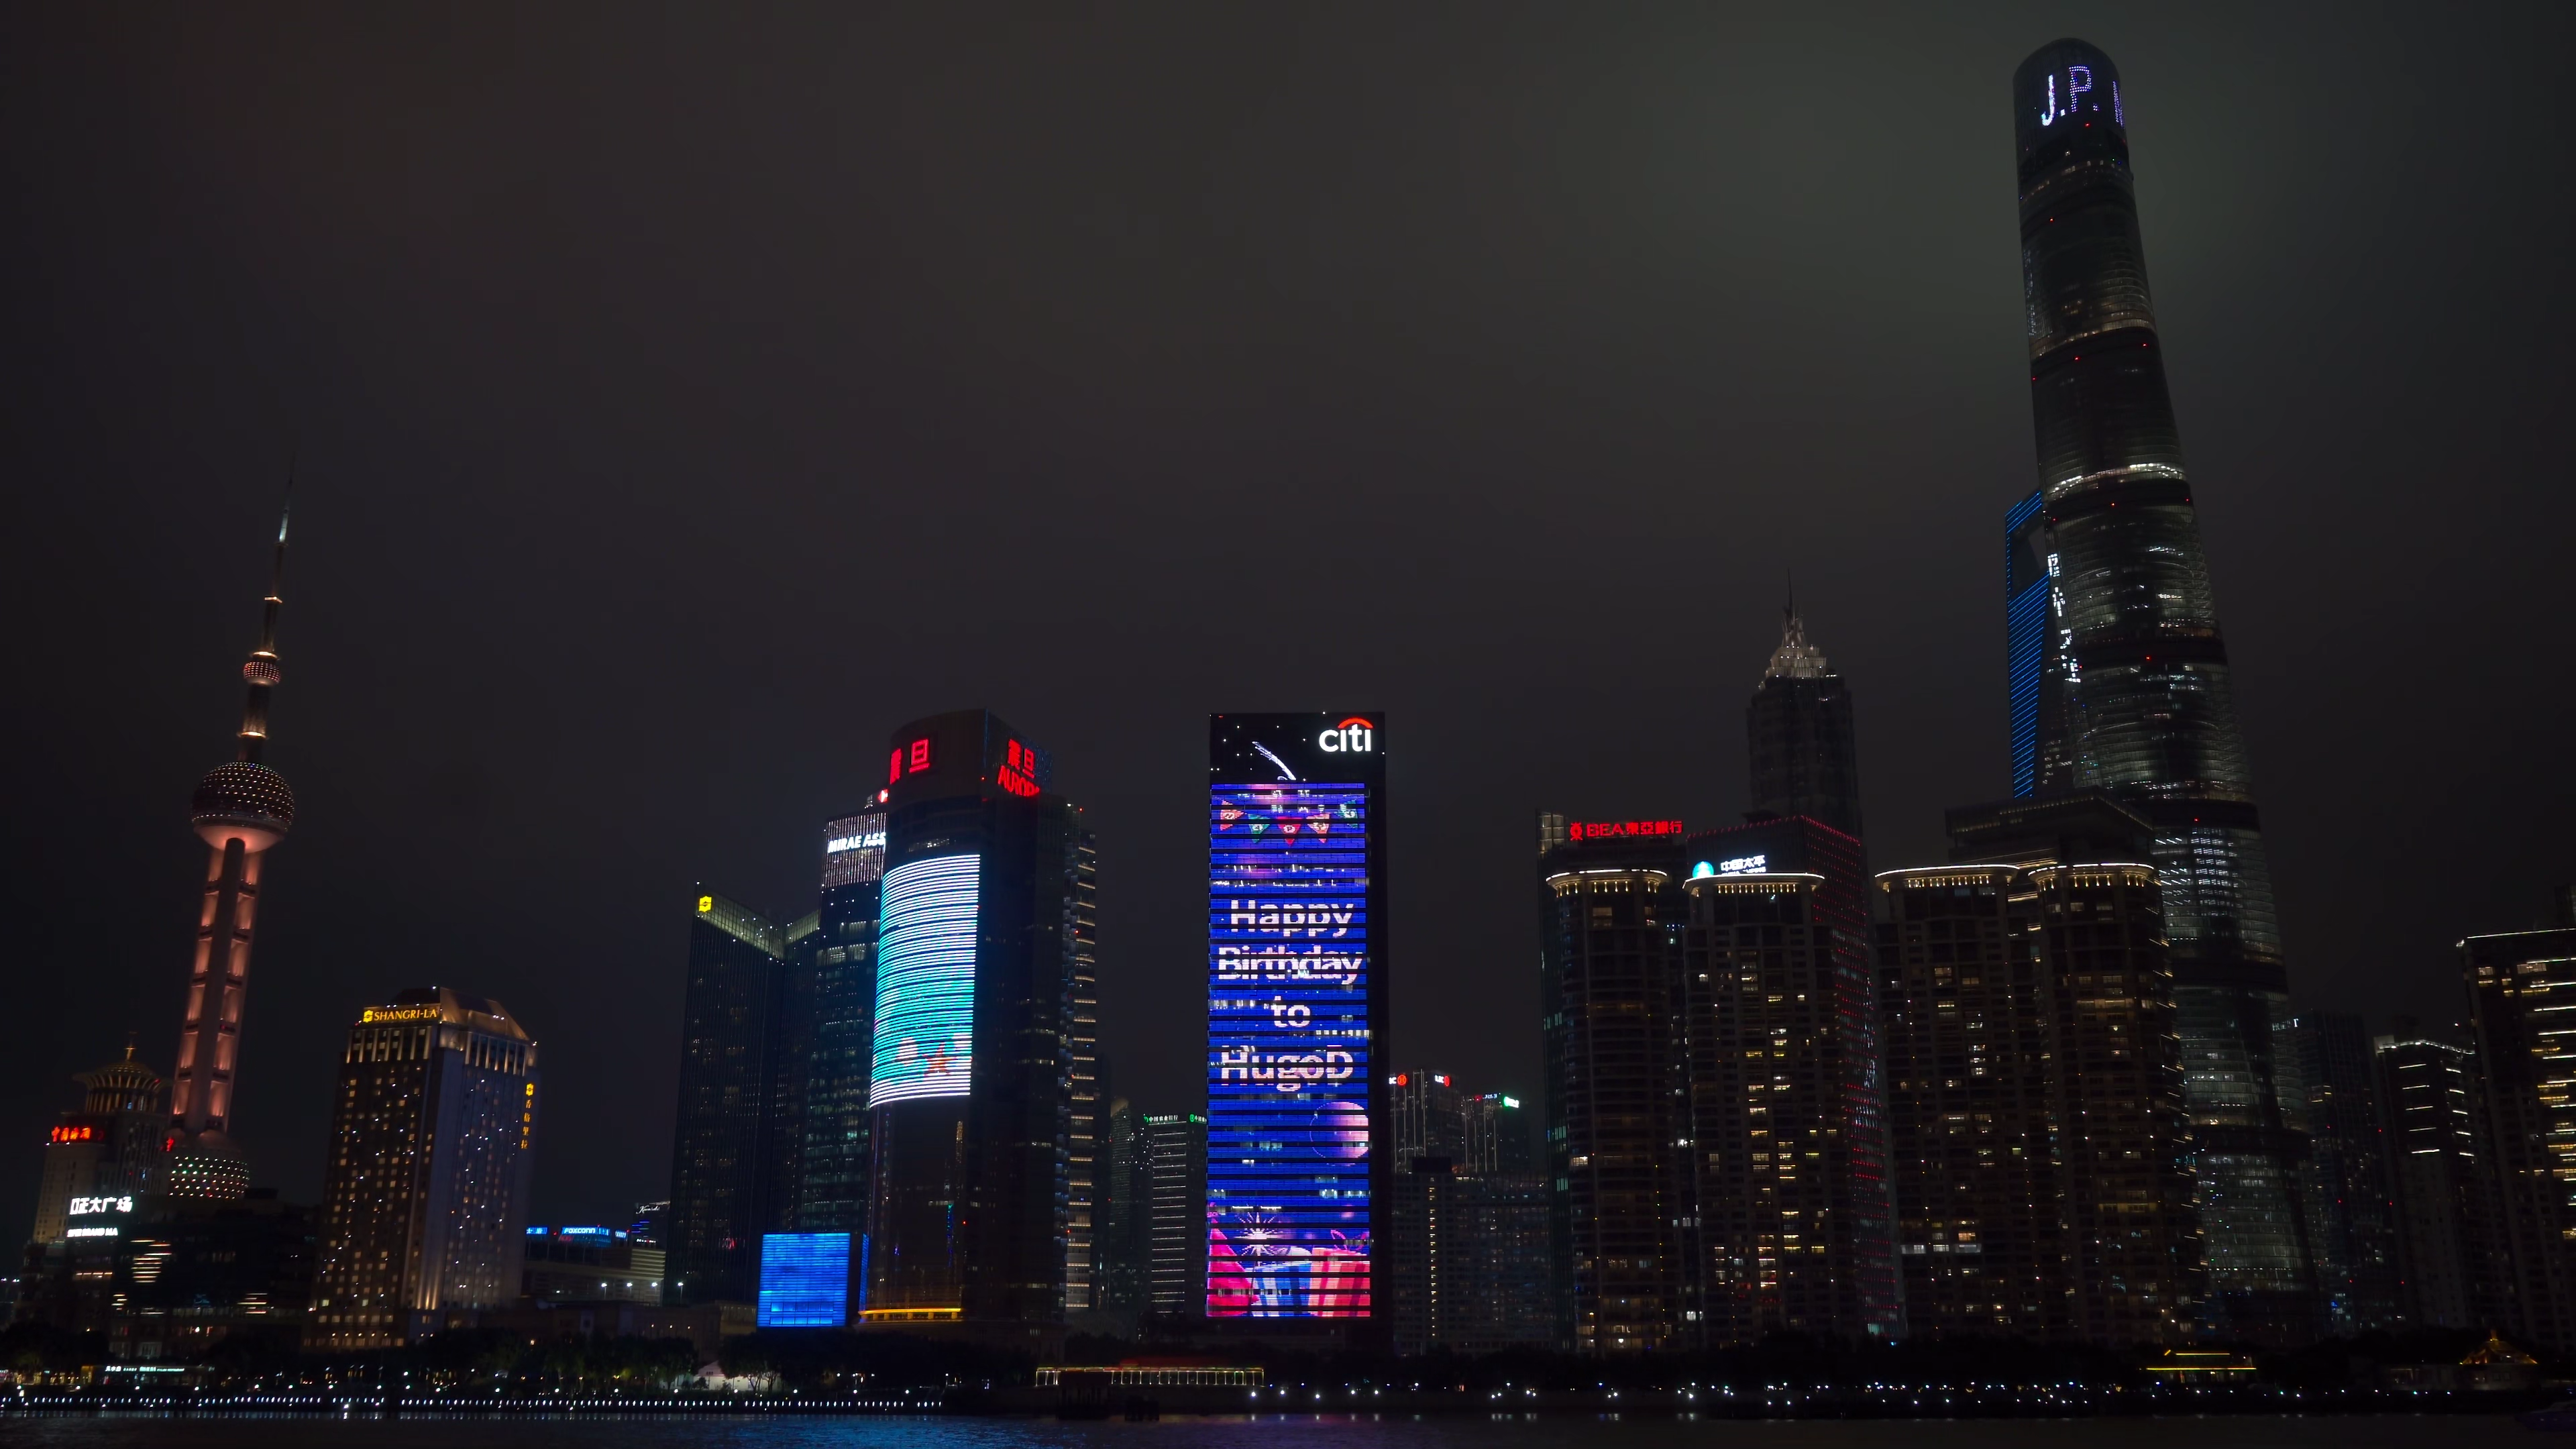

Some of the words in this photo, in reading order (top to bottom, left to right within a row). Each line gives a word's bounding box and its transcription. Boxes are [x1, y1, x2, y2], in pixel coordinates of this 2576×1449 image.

[1319, 723, 1372, 753] citi
[998, 765, 1040, 797] AUROR
[827, 835, 862, 853] MIRAE
[1587, 823, 1623, 837] BEA
[1720, 855, 1766, 871] 中国太平
[1231, 900, 1354, 937] Happy
[1218, 945, 1363, 985] Birthday
[374, 1008, 437, 1021] SHANGRI-LA
[1271, 996, 1311, 1028] to
[1221, 1045, 1353, 1092] HugoD
